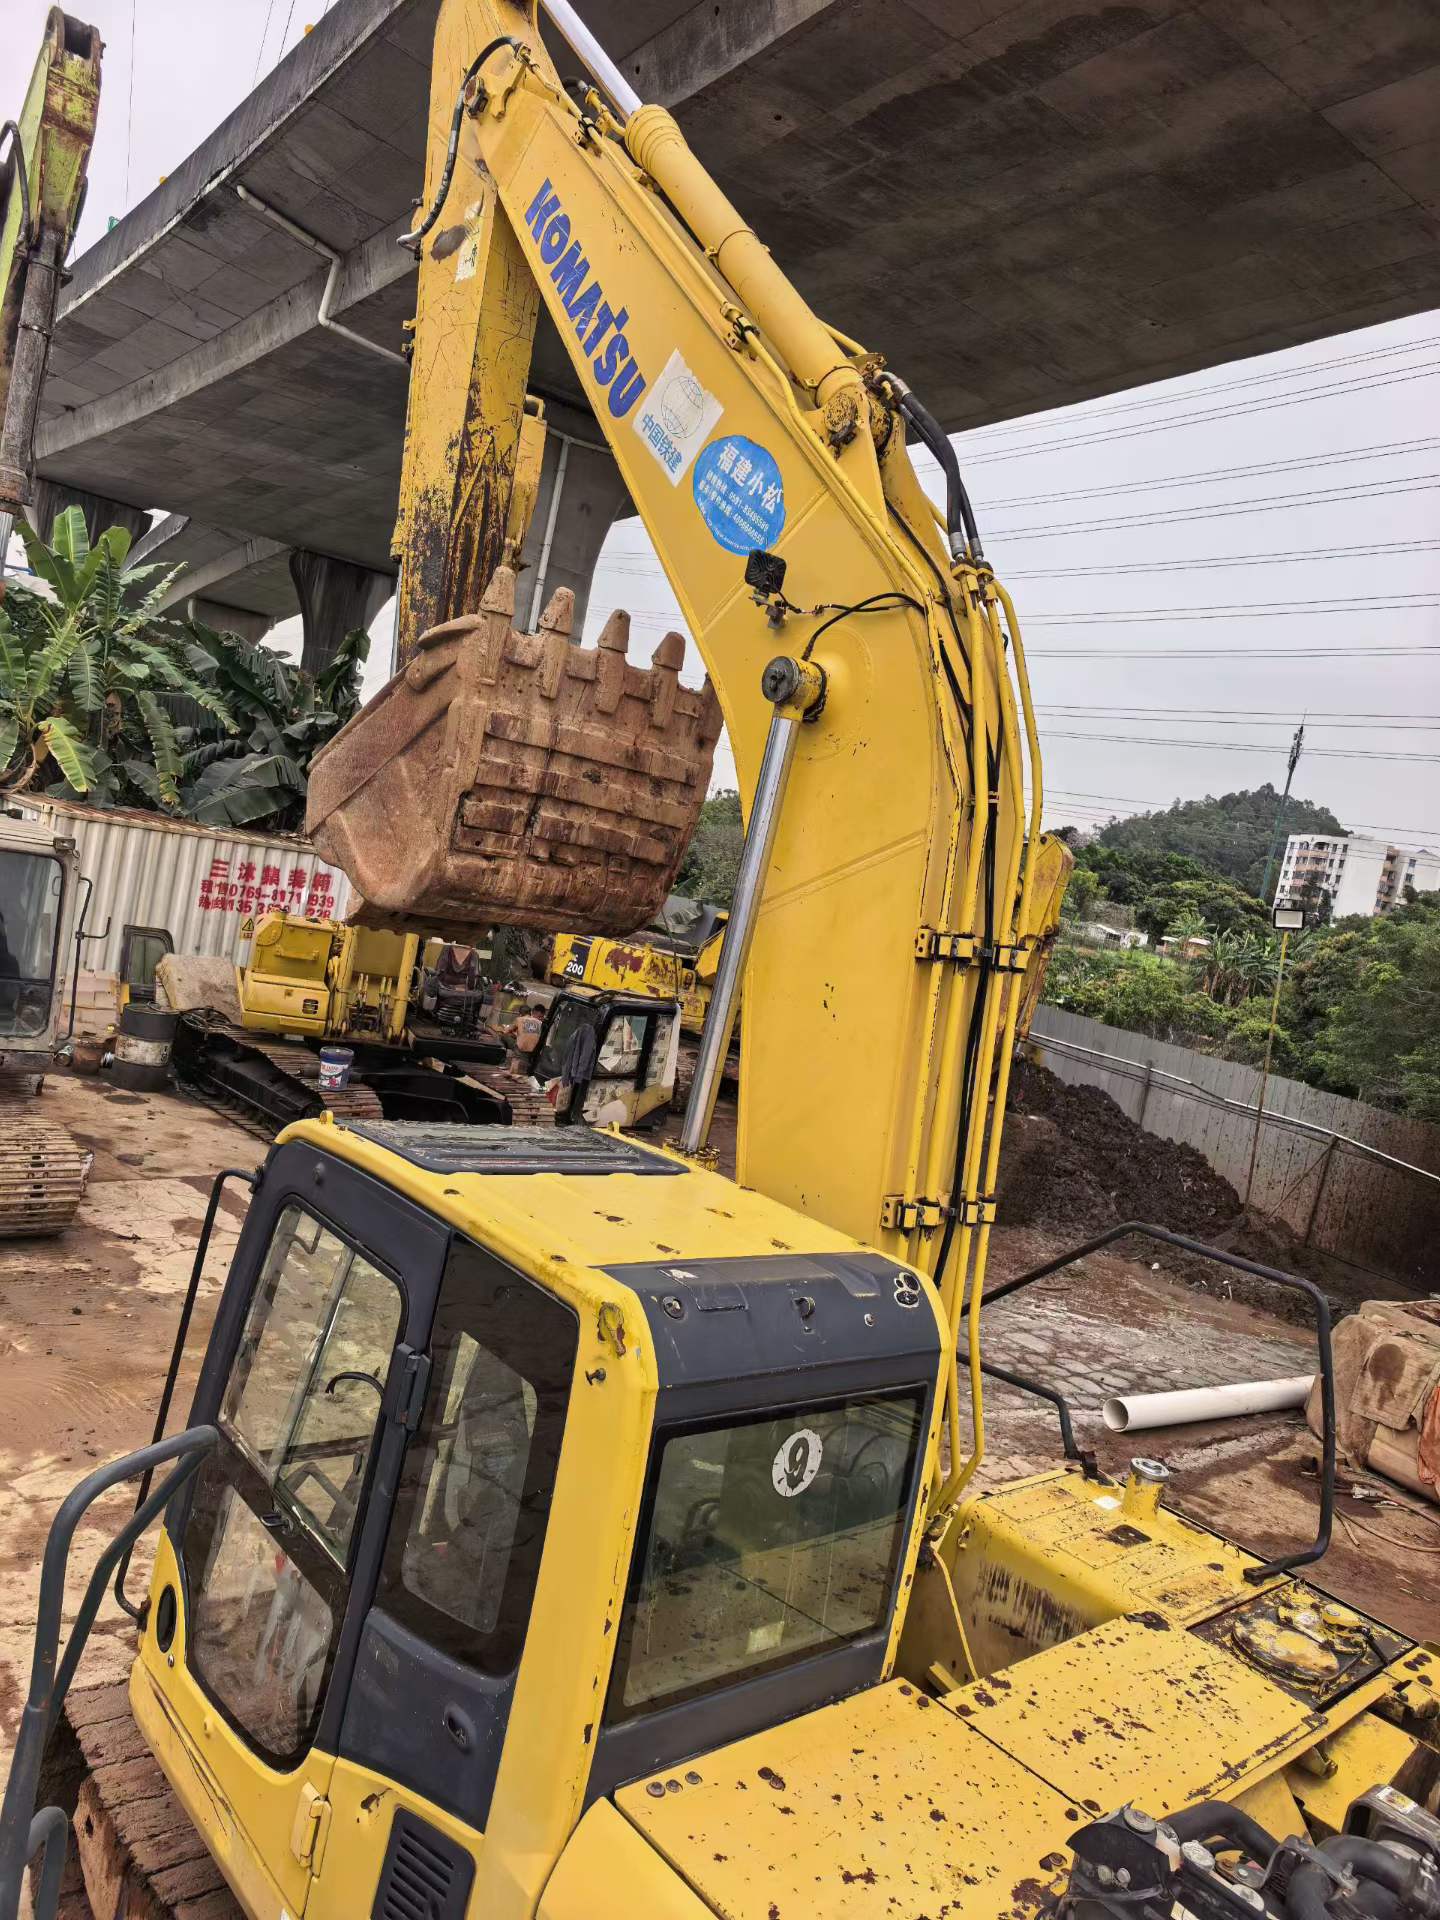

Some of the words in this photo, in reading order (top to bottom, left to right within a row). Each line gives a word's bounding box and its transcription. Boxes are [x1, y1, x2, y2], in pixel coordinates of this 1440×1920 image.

[525, 177, 646, 418] KOMATSU
[642, 414, 682, 474] 中国铁建
[718, 443, 783, 513] 福建小松
[566, 961, 584, 976] 200
